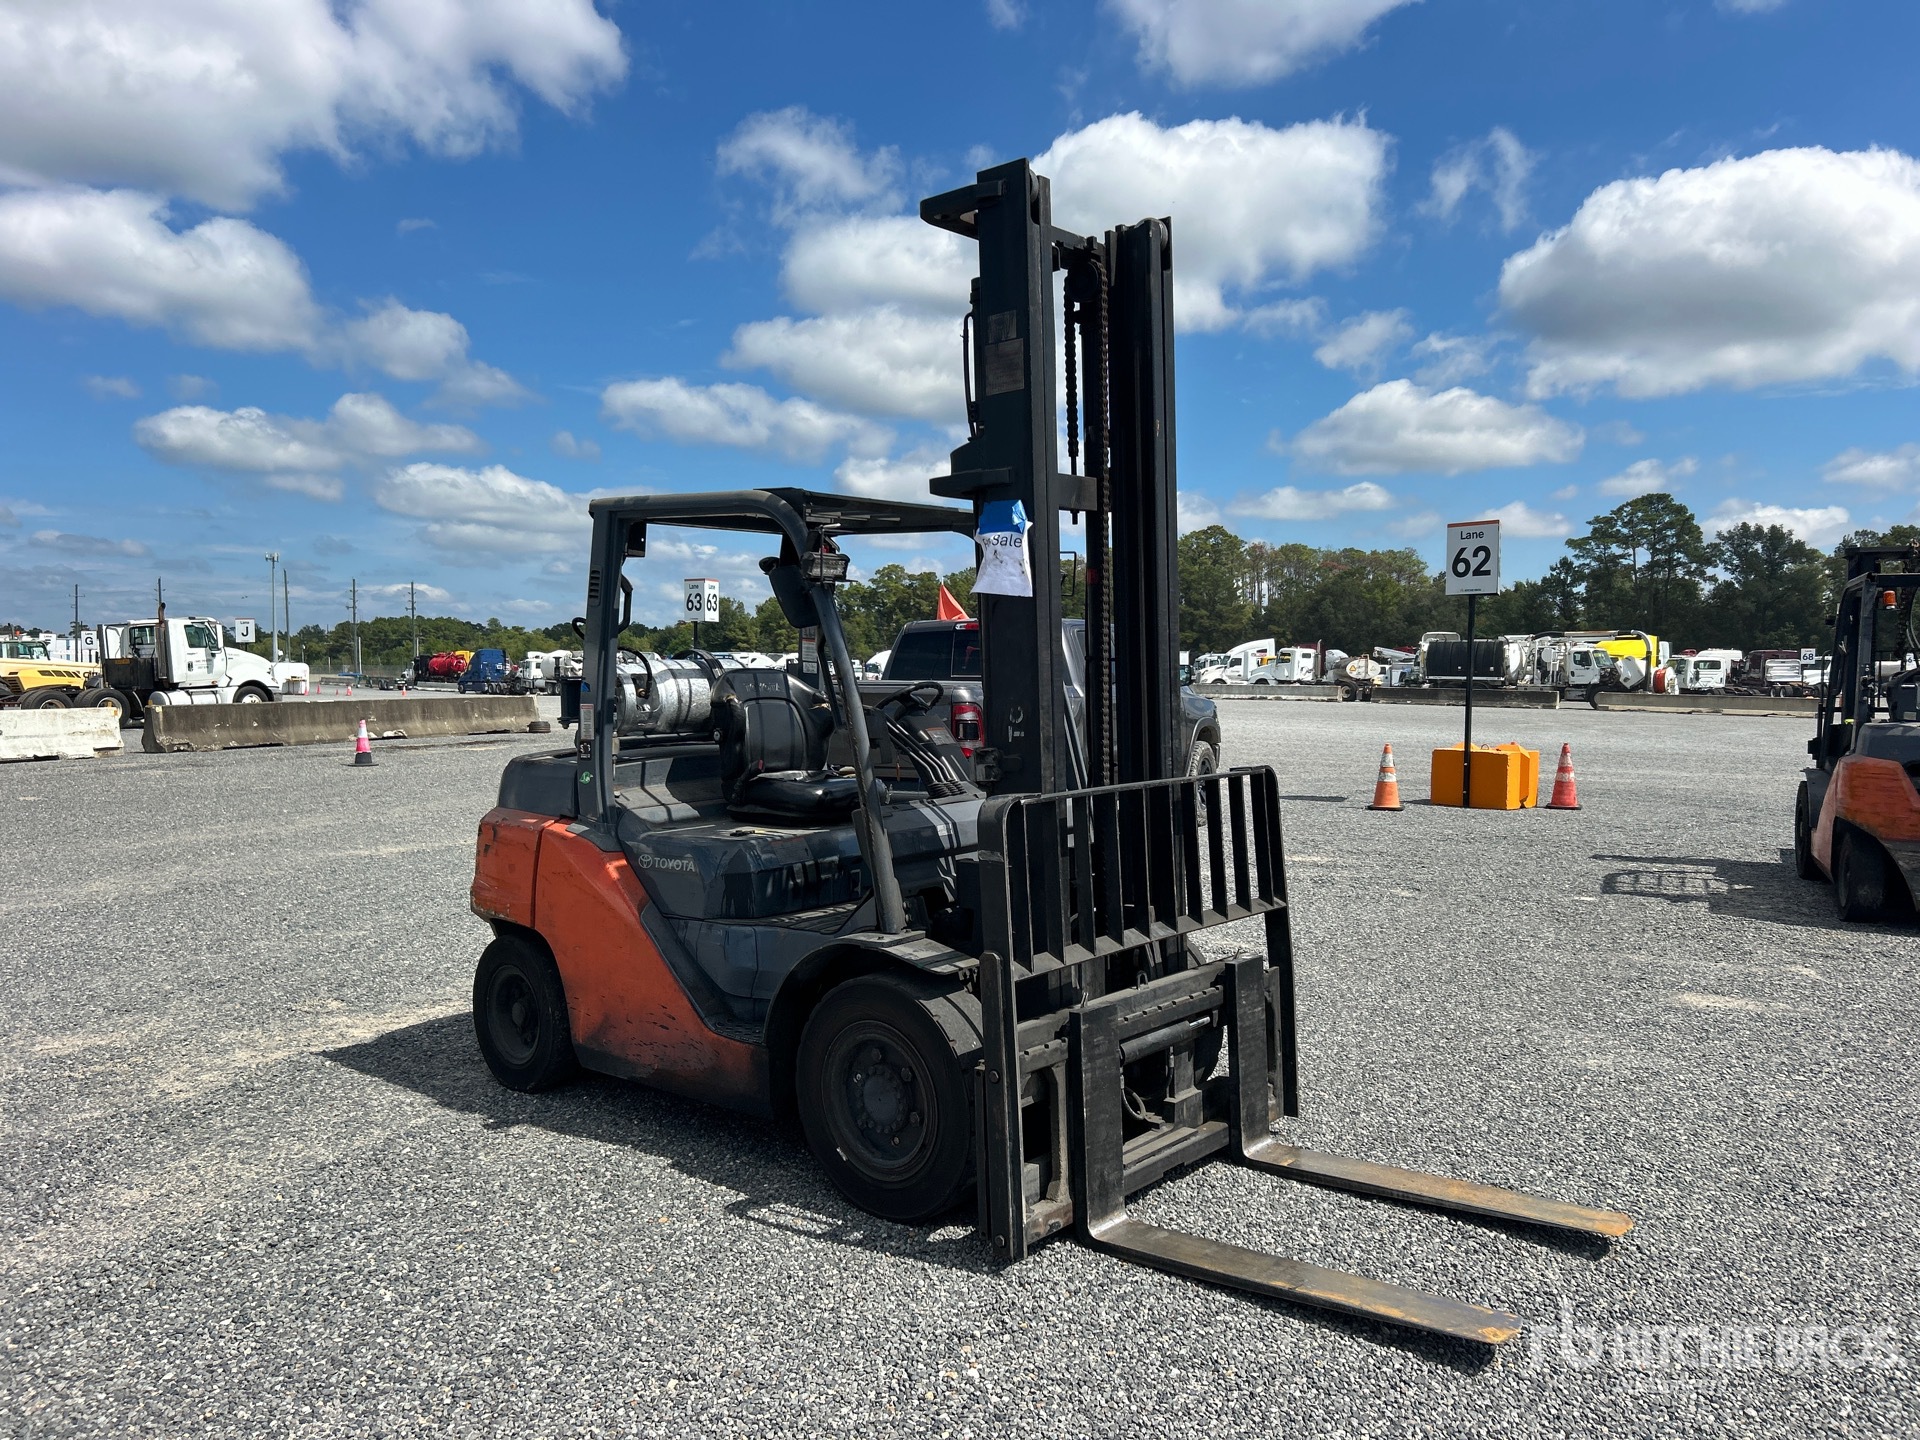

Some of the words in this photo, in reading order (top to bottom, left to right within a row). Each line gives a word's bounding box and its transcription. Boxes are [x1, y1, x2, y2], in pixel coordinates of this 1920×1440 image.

[1460, 531, 1485, 540] Lane
[1451, 545, 1492, 578] 62
[686, 592, 703, 612] 63
[706, 593, 718, 612] 63
[241, 626, 249, 637] J
[84, 636, 94, 646] G
[1802, 653, 1814, 661] 68
[654, 857, 696, 873] TOYOTA
